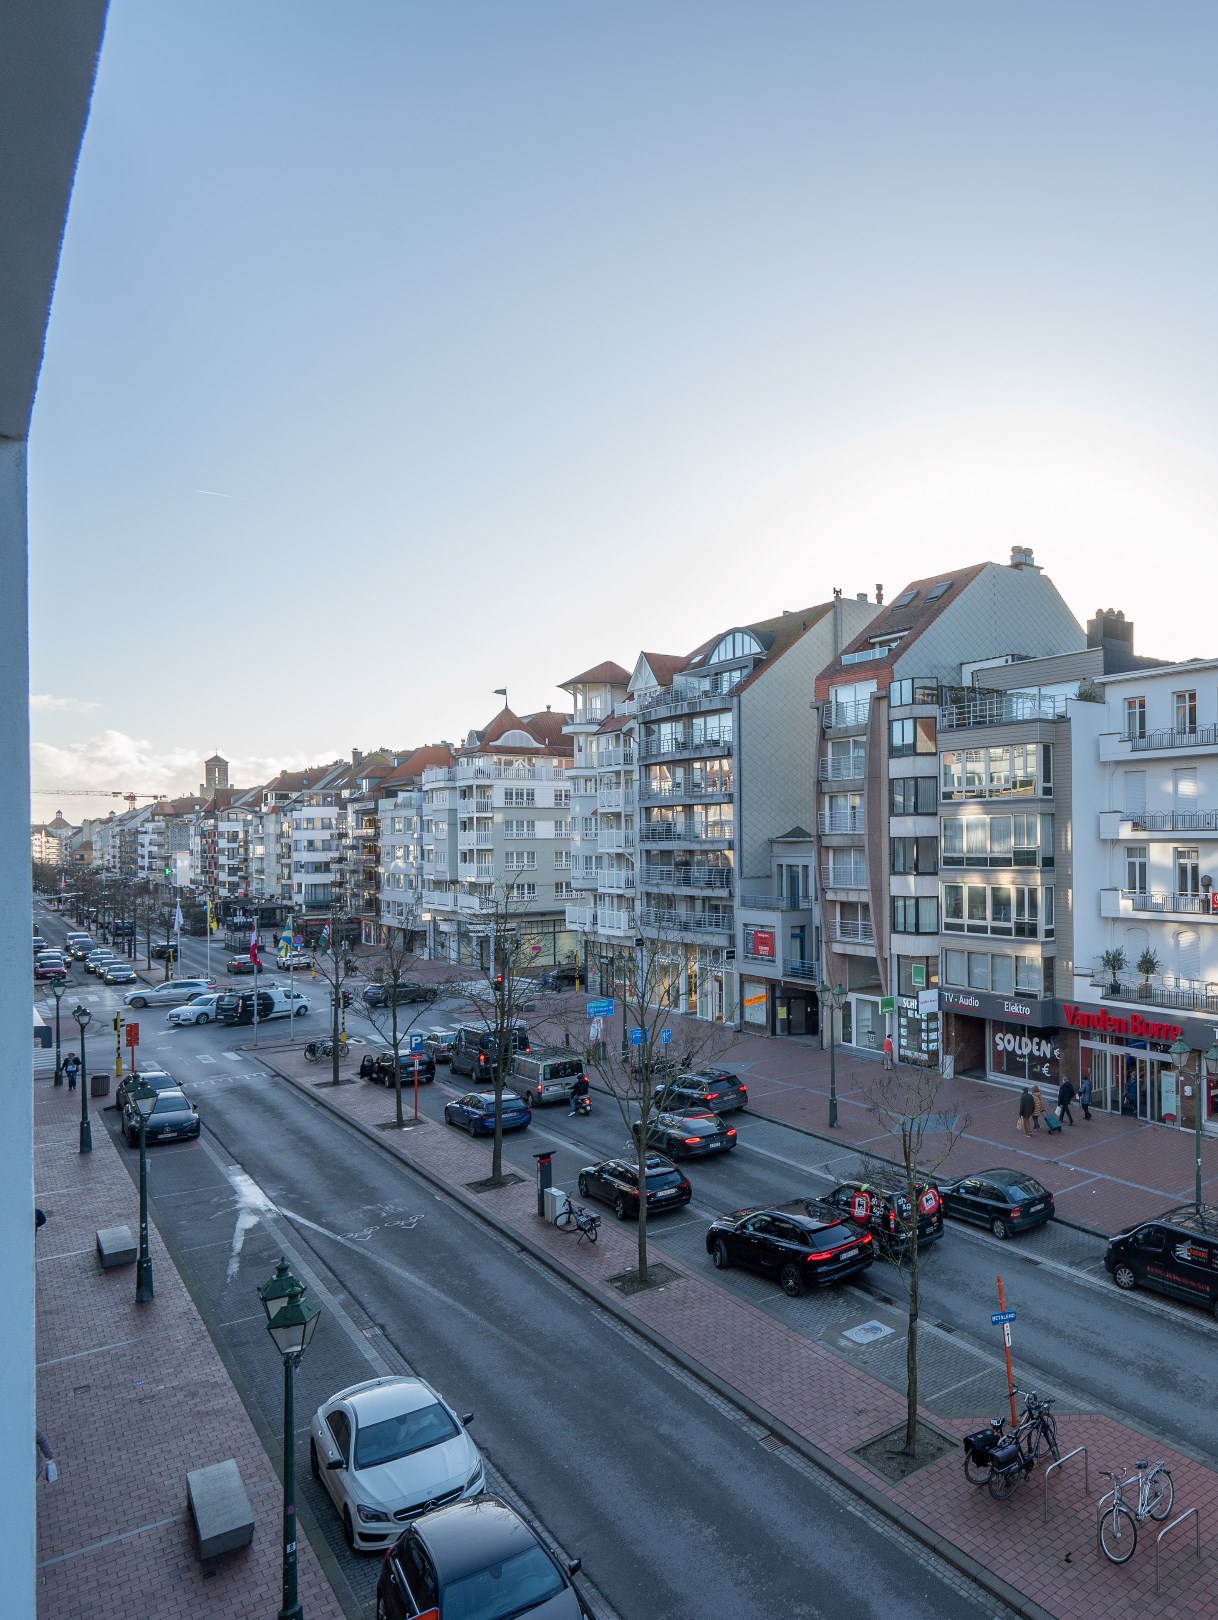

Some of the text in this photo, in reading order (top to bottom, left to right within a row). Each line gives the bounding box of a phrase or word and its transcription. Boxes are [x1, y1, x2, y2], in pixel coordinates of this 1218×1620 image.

[944, 993, 953, 1003] TV
[959, 994, 980, 1007] Audio
[1004, 1002, 1030, 1015] Elektro
[1063, 1004, 1183, 1041] Vanden Borre
[411, 1036, 421, 1048] P
[995, 1033, 1051, 1058] SOLDEN
